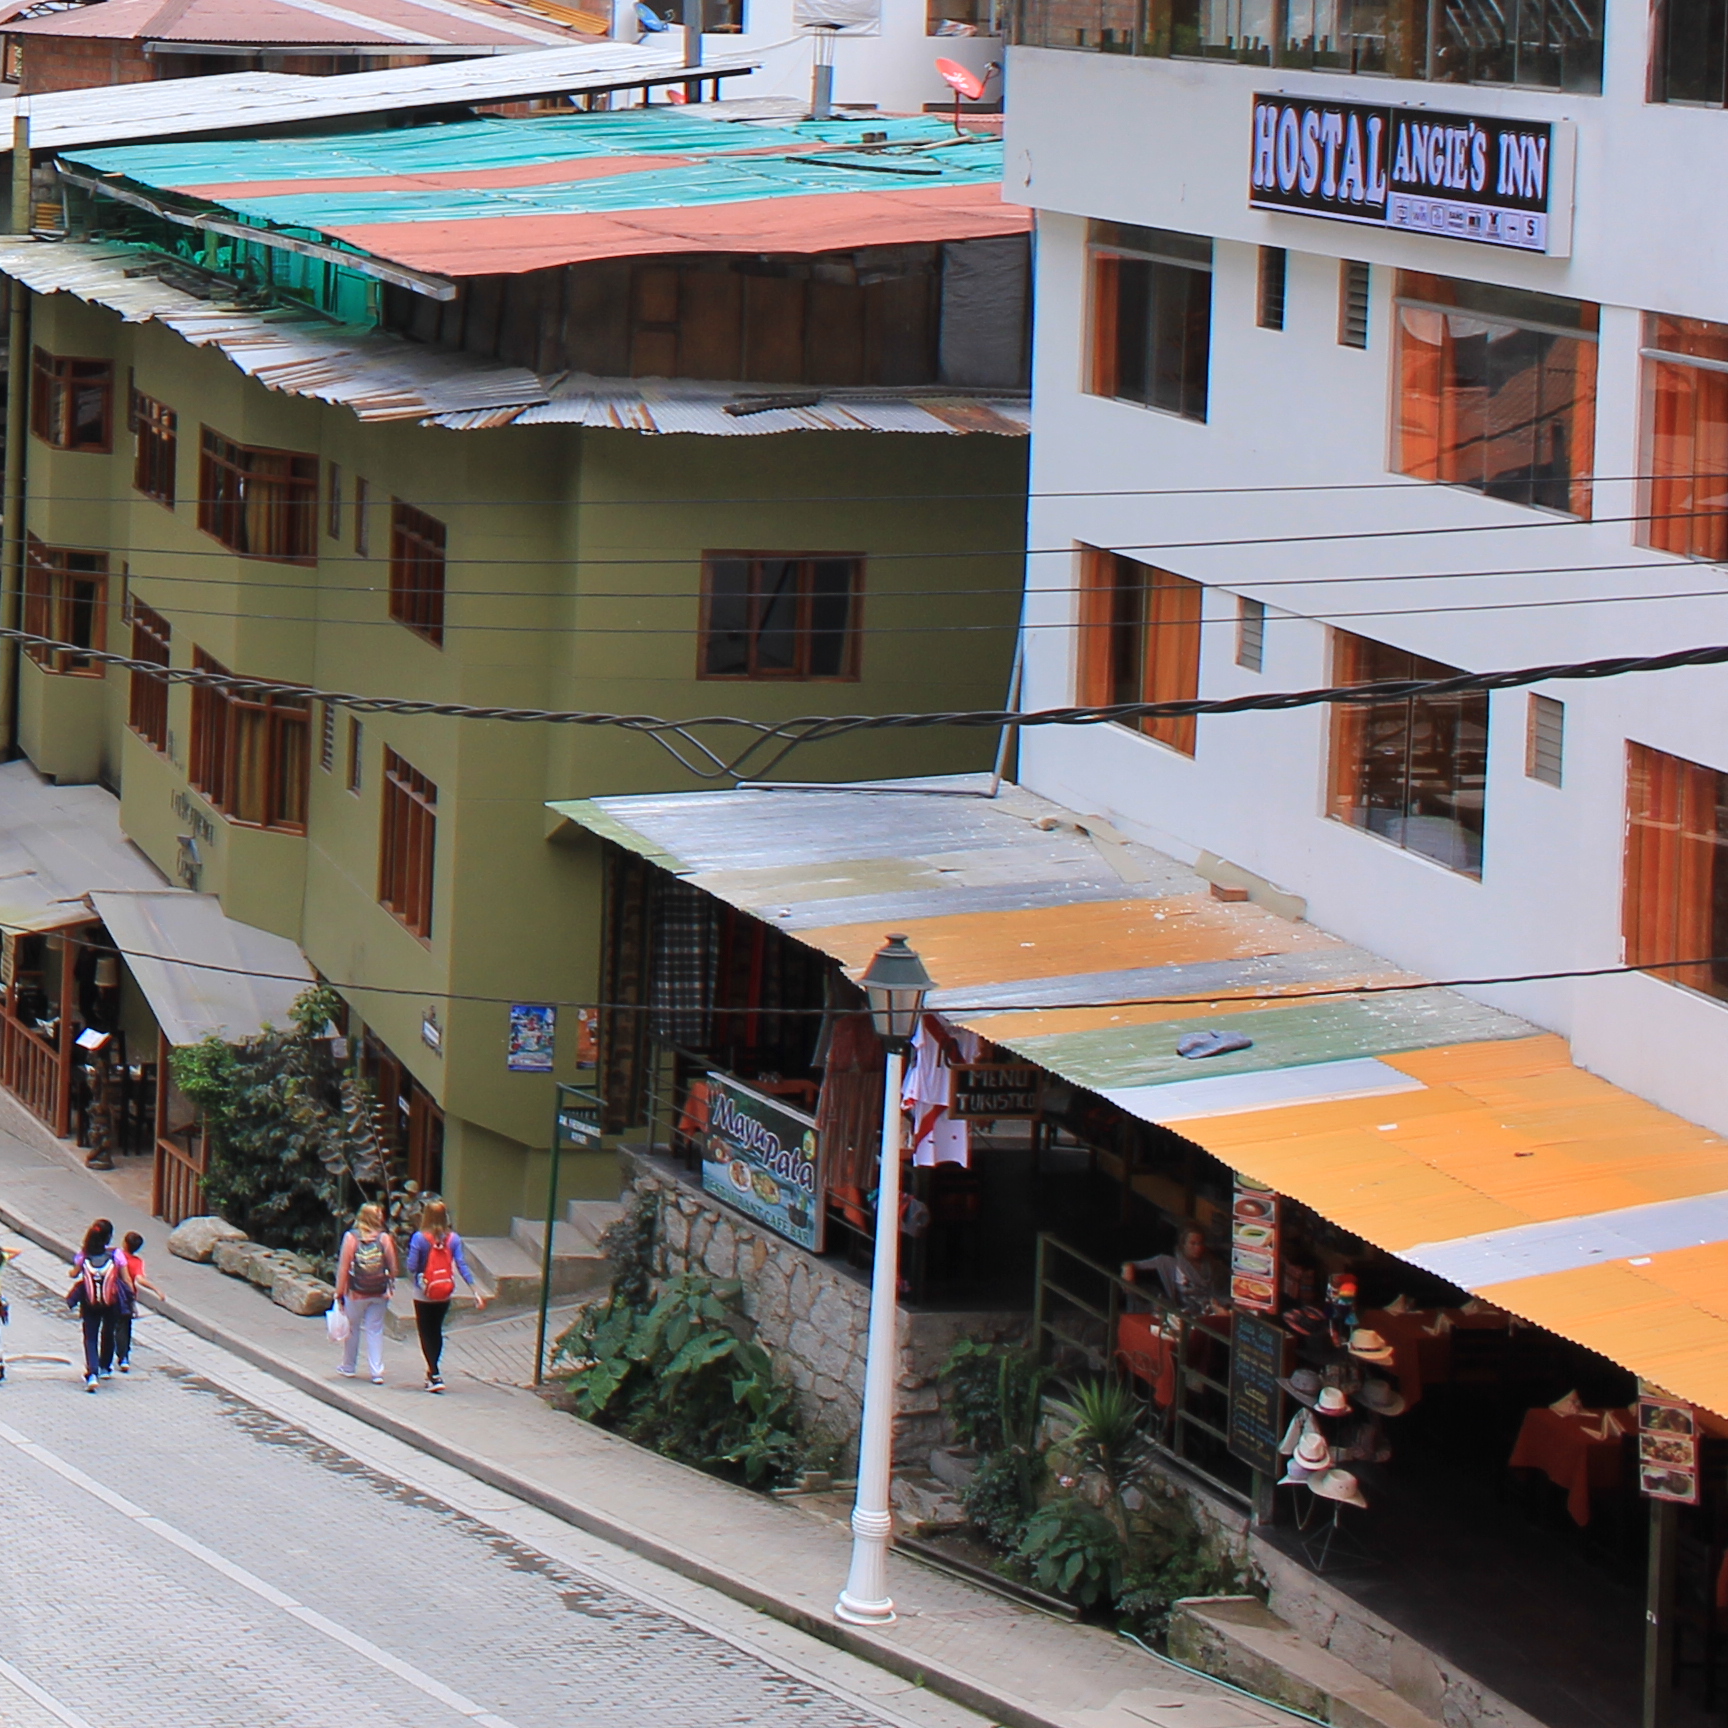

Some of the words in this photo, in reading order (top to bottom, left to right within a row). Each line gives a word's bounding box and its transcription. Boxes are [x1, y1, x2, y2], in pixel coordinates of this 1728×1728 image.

[1253, 104, 1386, 208] HOSTAL
[1393, 120, 1485, 192] ANGIE'S
[1497, 131, 1546, 200] INN
